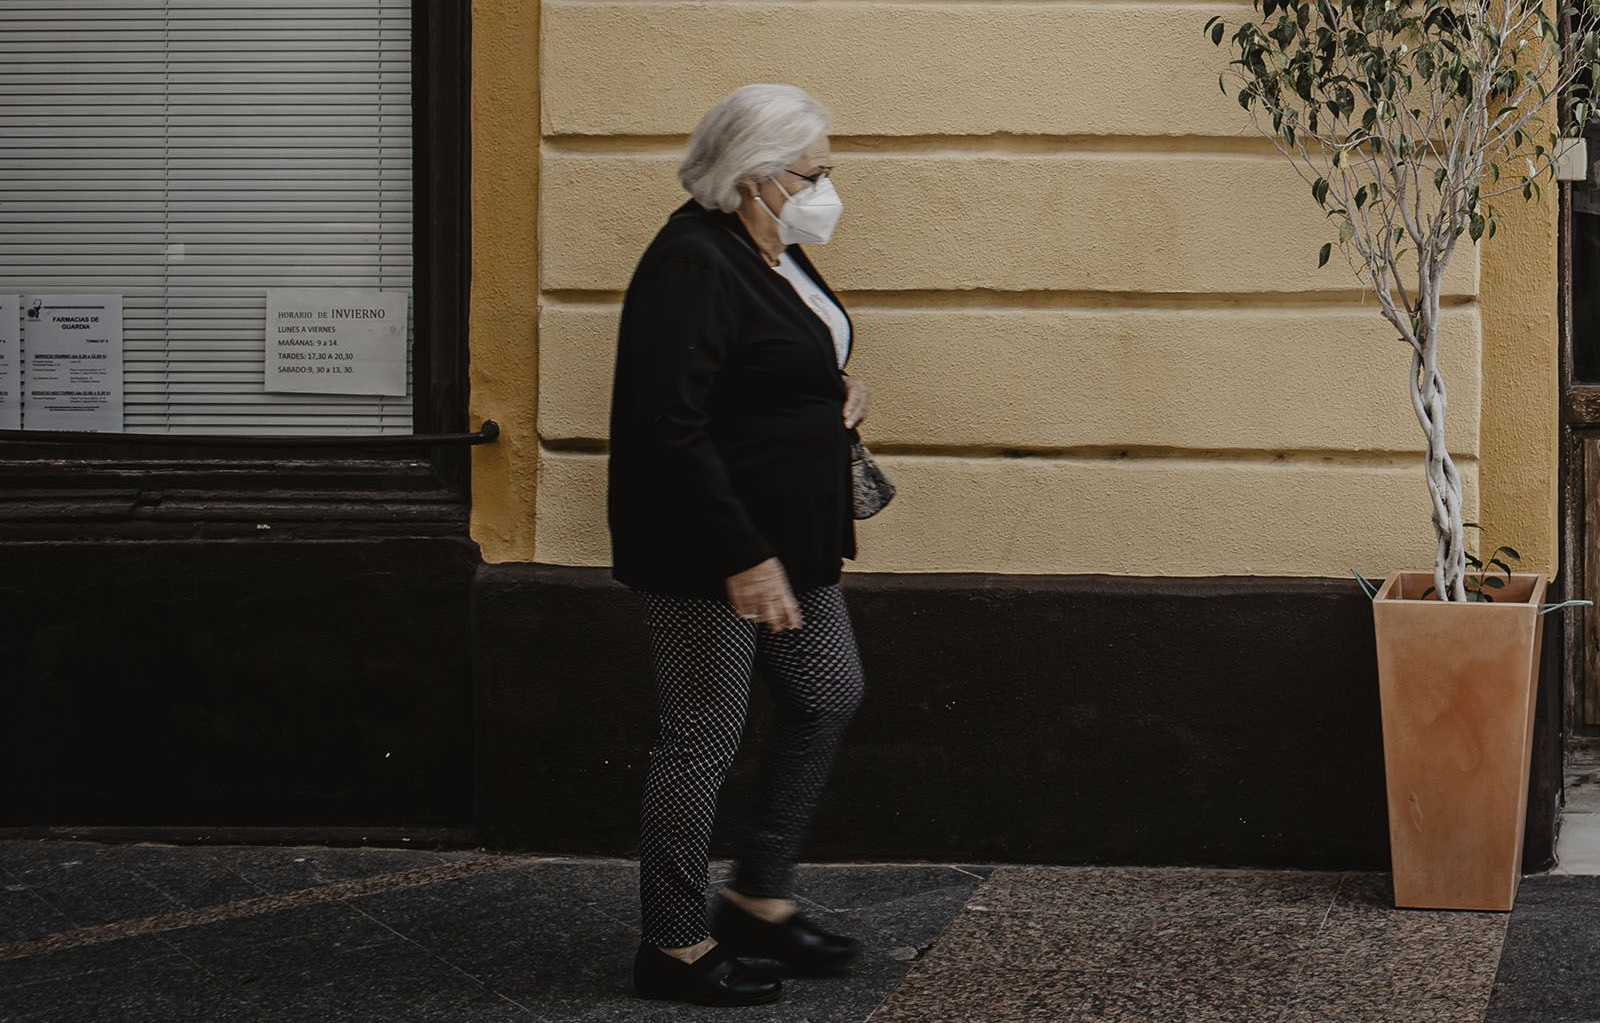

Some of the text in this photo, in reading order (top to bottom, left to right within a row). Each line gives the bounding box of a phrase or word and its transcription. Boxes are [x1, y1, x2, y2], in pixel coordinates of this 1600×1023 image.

[278, 308, 386, 319] HORARIO DE INVIERNO
[308, 325, 336, 333] VIERNES
[334, 353, 354, 361] 20,30
